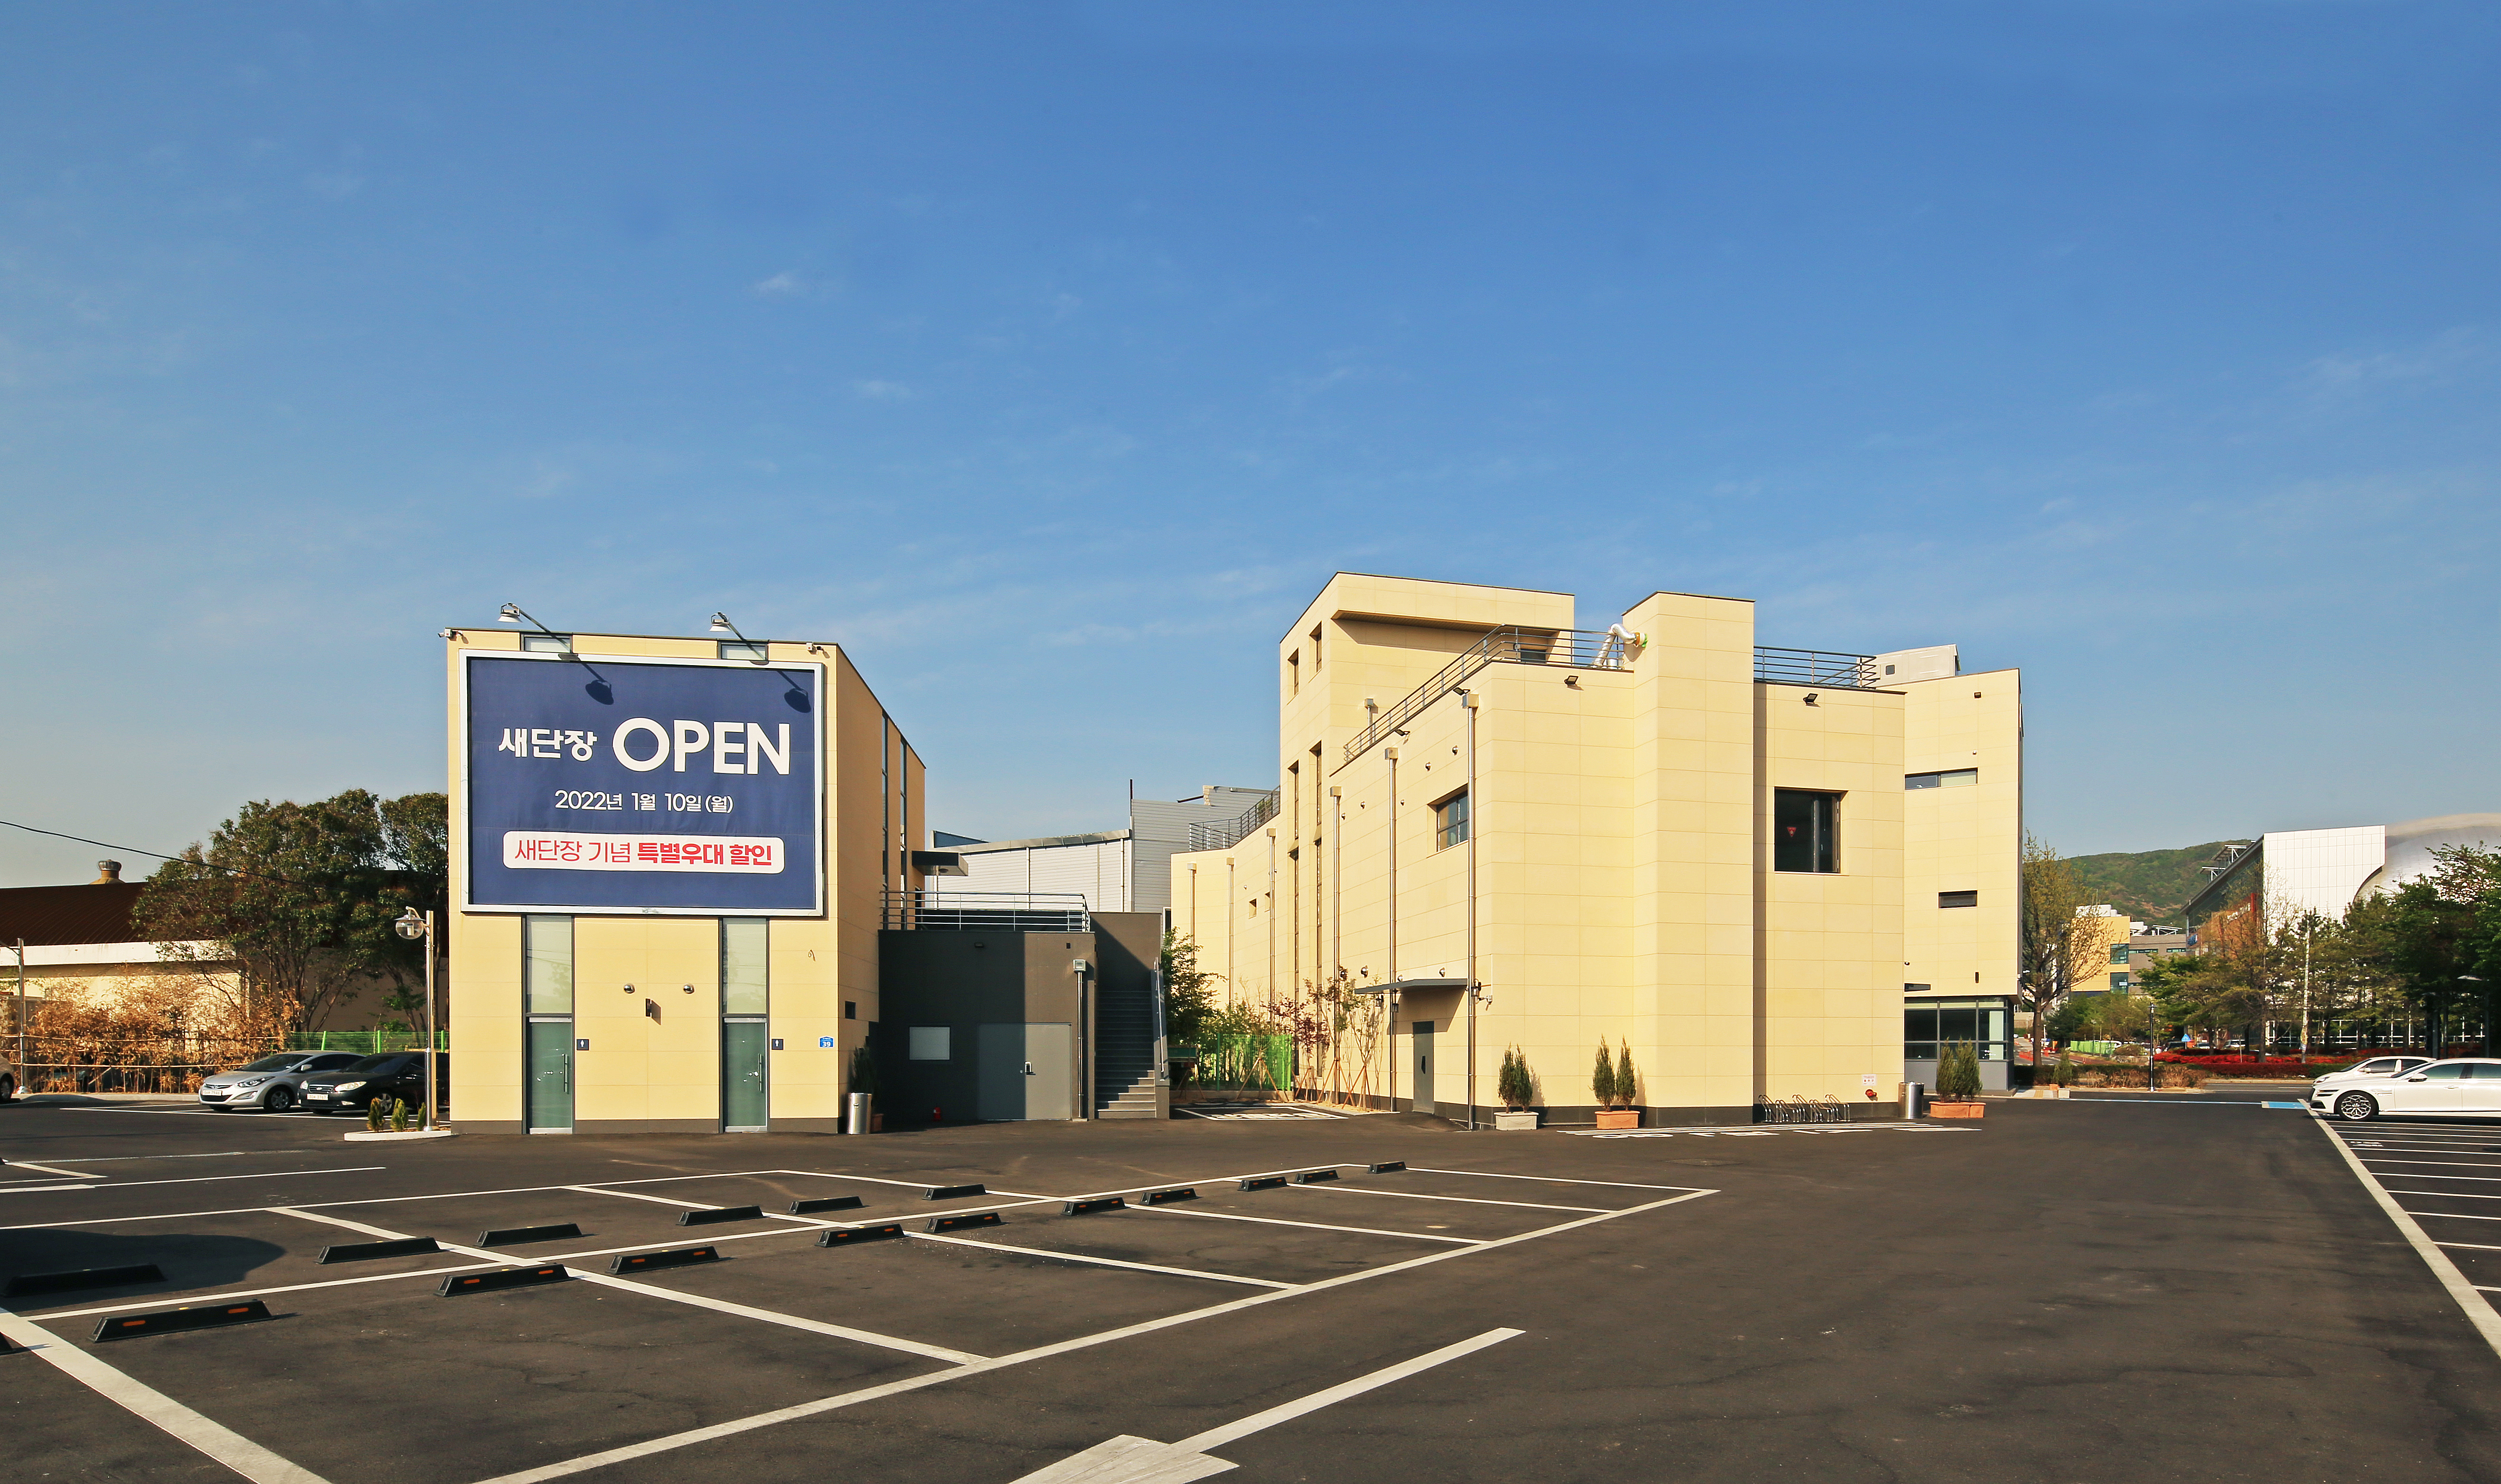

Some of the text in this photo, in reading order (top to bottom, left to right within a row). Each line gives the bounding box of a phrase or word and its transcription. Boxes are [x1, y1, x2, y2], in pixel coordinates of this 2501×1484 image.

[498, 717, 790, 775] 새단장 OPEN
[555, 790, 733, 813] 2022년 1월 10일 (월)
[515, 839, 772, 866] 새단장 기념 특별우대 할인
